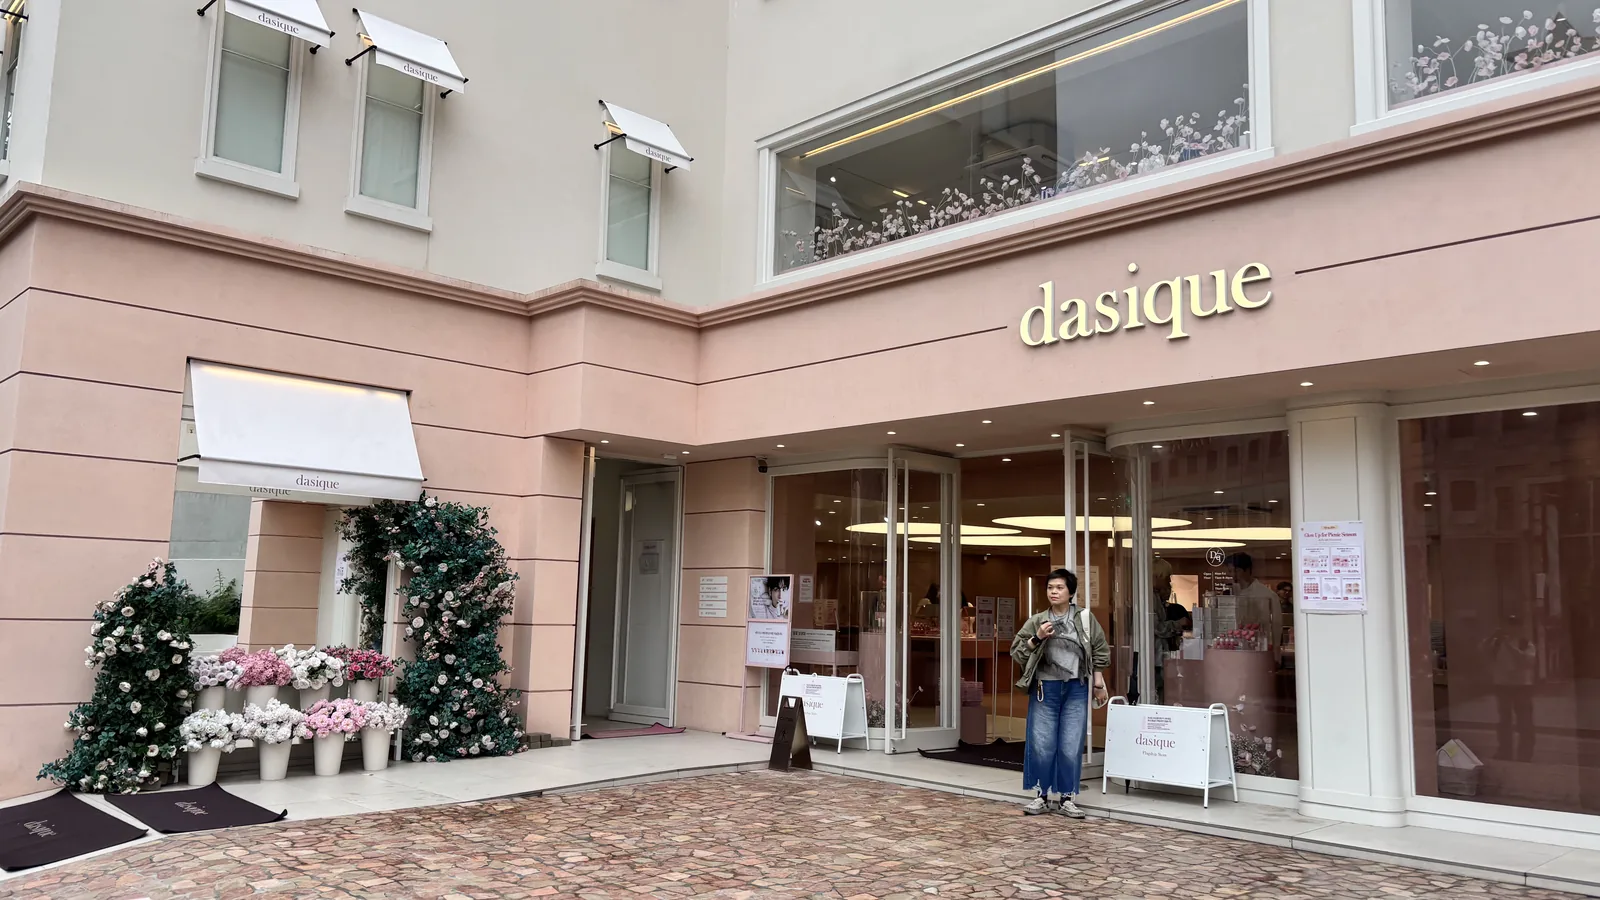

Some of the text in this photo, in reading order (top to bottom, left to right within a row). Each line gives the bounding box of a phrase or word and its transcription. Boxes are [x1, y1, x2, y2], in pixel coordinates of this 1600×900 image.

[258, 13, 299, 34] dasique
[403, 63, 438, 81] dasique
[645, 147, 671, 162] dasique
[1019, 262, 1273, 346] dasique
[296, 474, 340, 490] dasique
[1135, 733, 1176, 750] dasique
